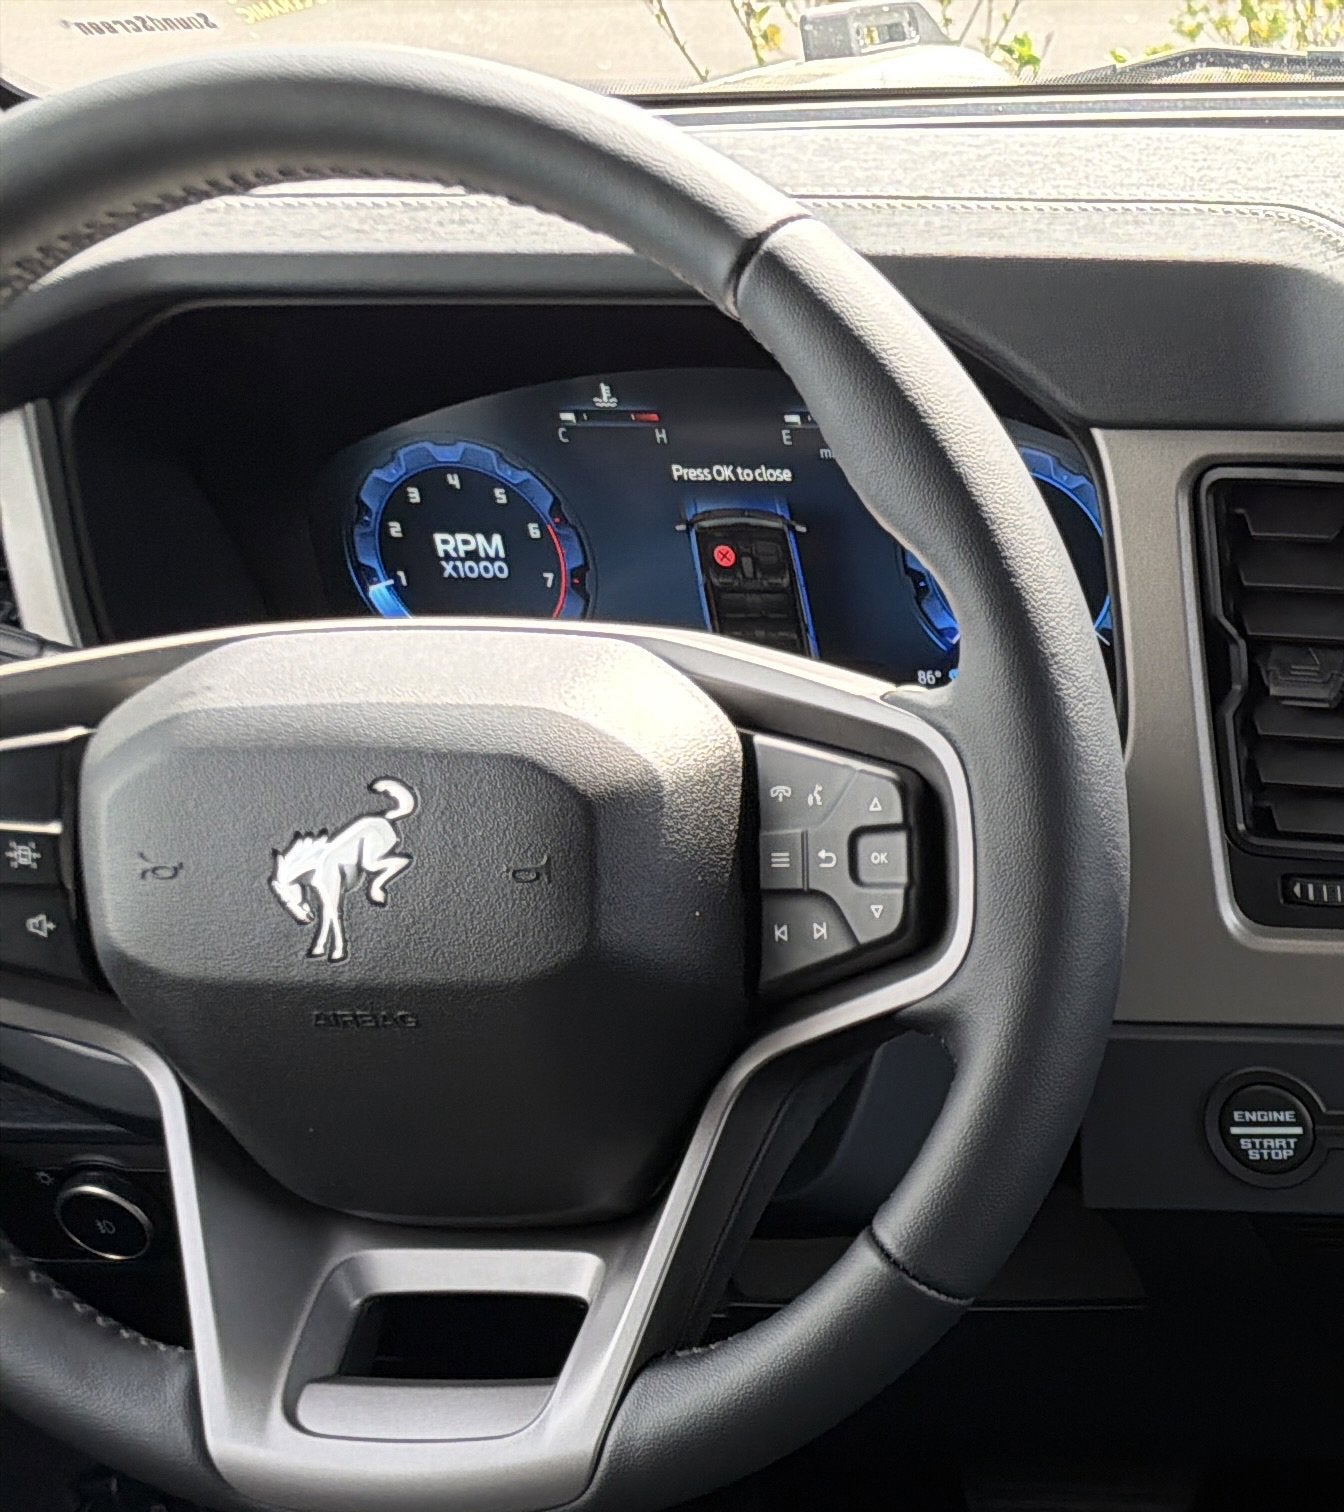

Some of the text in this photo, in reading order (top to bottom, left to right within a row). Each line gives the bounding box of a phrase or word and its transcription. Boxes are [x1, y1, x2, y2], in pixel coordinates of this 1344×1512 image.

[558, 428, 570, 443] C
[655, 428, 668, 444] H
[782, 430, 793, 446] E
[446, 473, 461, 489] 4
[671, 464, 793, 482] Press OK to close
[407, 487, 421, 504] 3
[494, 488, 508, 504] 5
[388, 521, 403, 538] 2
[528, 522, 541, 539] 6
[433, 532, 506, 559] RPM
[442, 559, 509, 580] X1000
[396, 570, 408, 587] 1
[542, 572, 555, 588] 7
[871, 852, 888, 865] OK
[312, 1010, 420, 1029] AIRBAG
[1233, 1110, 1297, 1122] ENGINE
[1240, 1138, 1298, 1150] START
[1248, 1150, 1294, 1160] STOP
